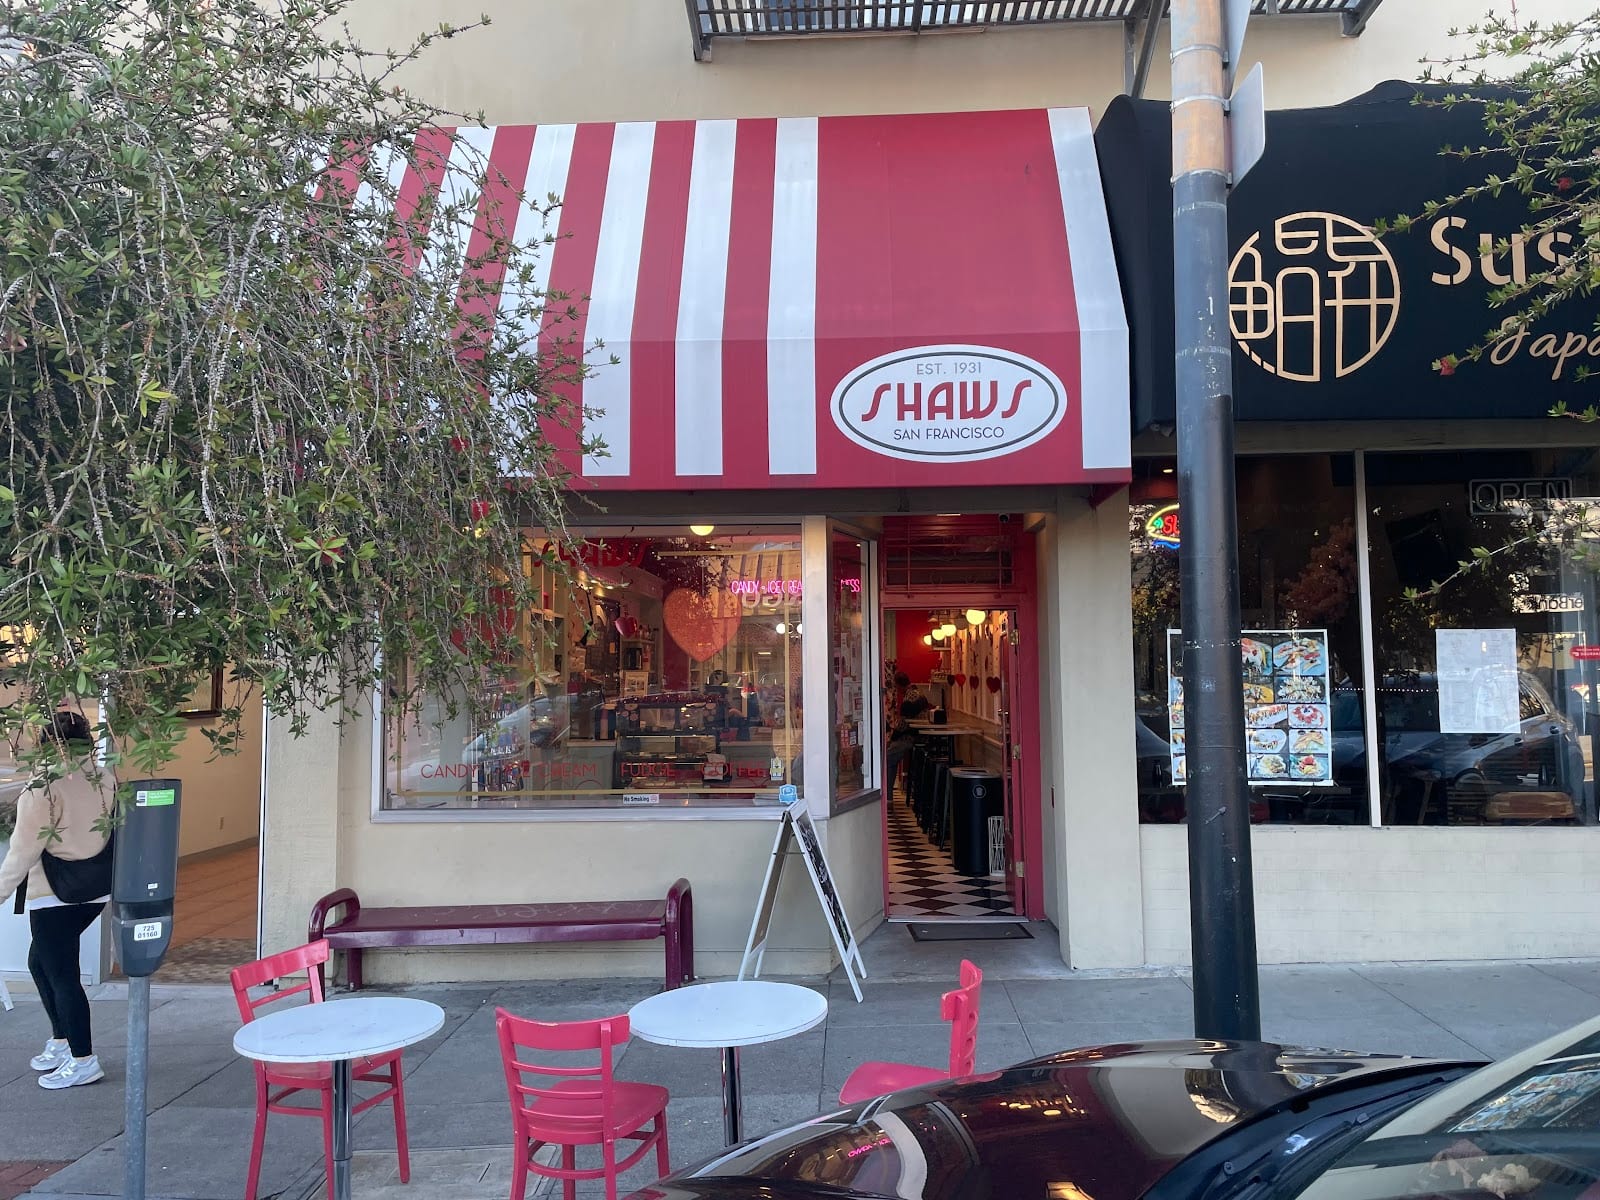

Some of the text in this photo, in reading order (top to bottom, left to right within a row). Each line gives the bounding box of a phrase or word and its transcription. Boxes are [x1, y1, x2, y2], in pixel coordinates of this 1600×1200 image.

[916, 361, 982, 375] EST. 1931
[861, 379, 1032, 422] SHAWS
[893, 426, 1005, 440] SAN FRANCISCO
[1476, 482, 1567, 510] OPEN
[731, 580, 759, 594] CANDY
[421, 763, 479, 779] CANDY
[620, 762, 676, 777] FUDGE
[631, 795, 650, 803] Smoking
